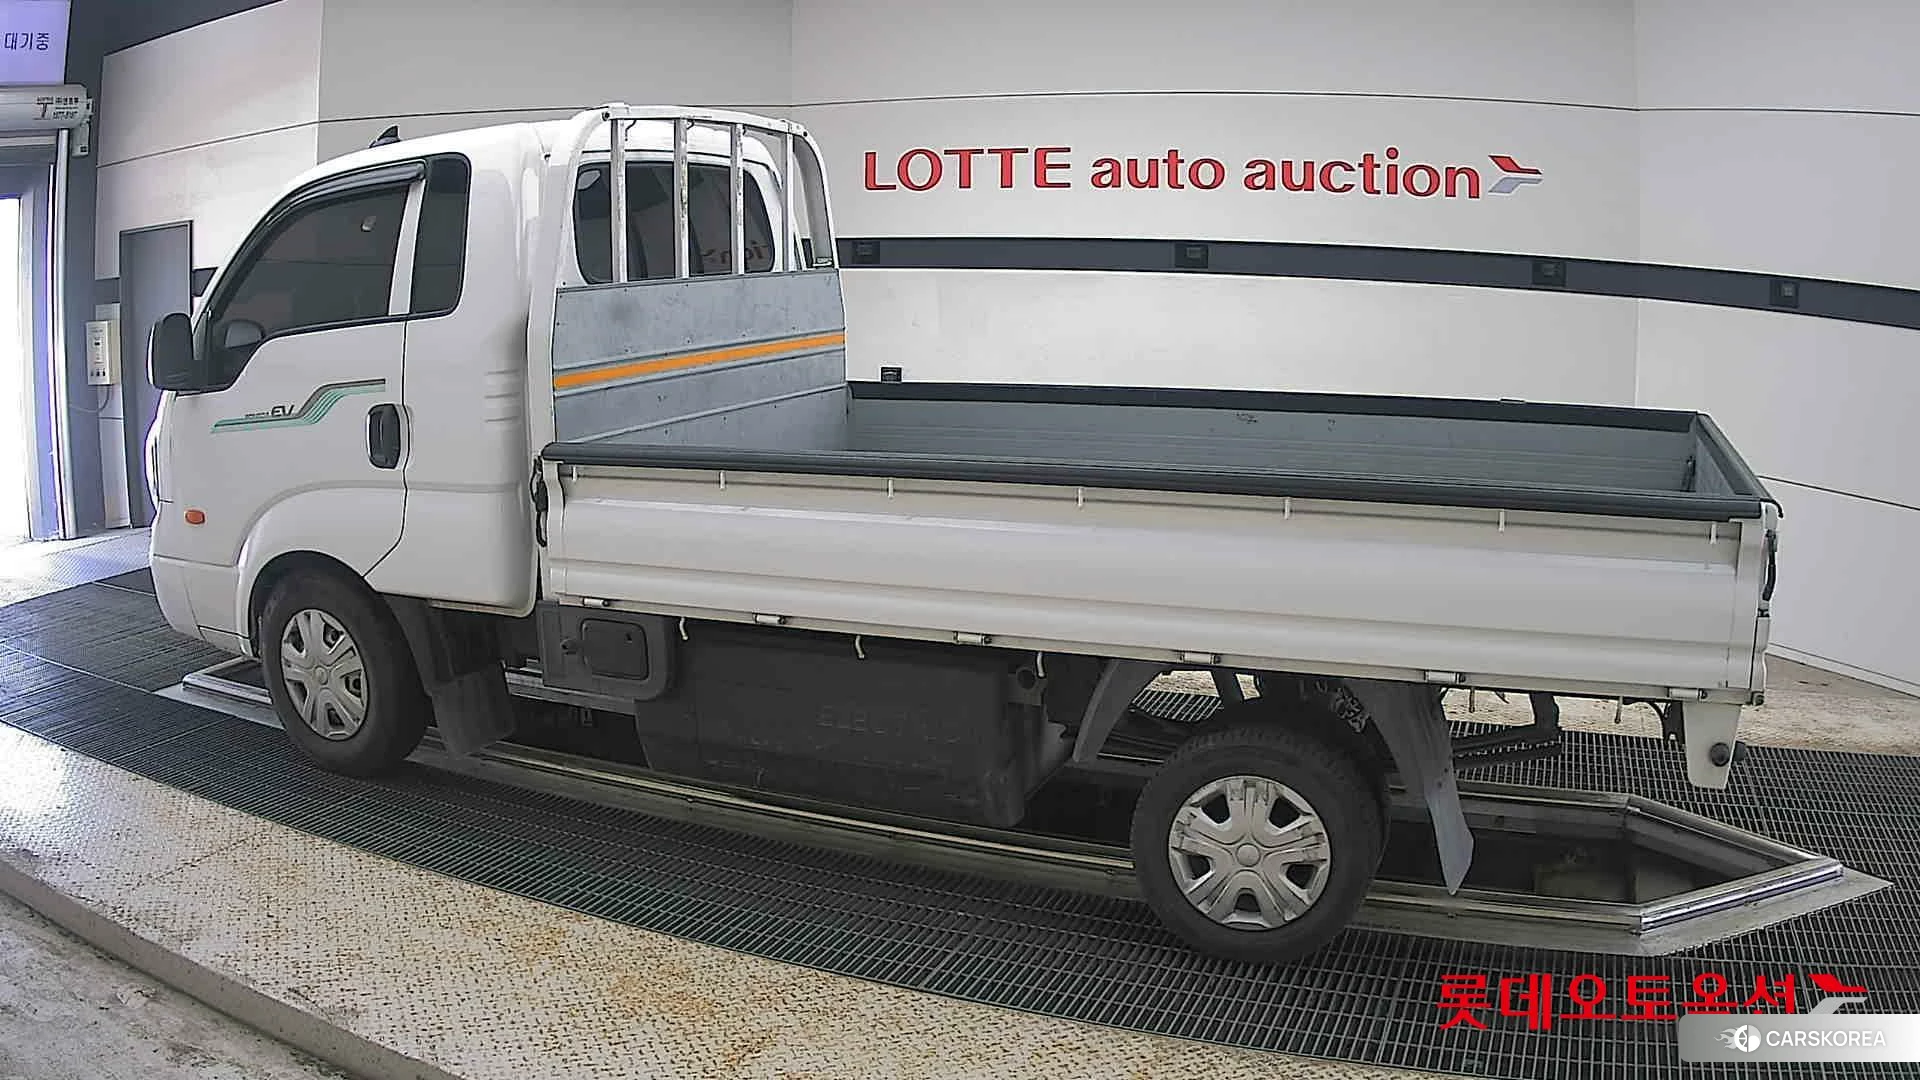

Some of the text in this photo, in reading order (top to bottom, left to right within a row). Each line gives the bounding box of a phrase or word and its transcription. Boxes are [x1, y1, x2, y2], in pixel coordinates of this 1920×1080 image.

[4, 32, 49, 50] 대기중
[864, 147, 1480, 198] LOTTE auto auction
[271, 404, 295, 417] EV
